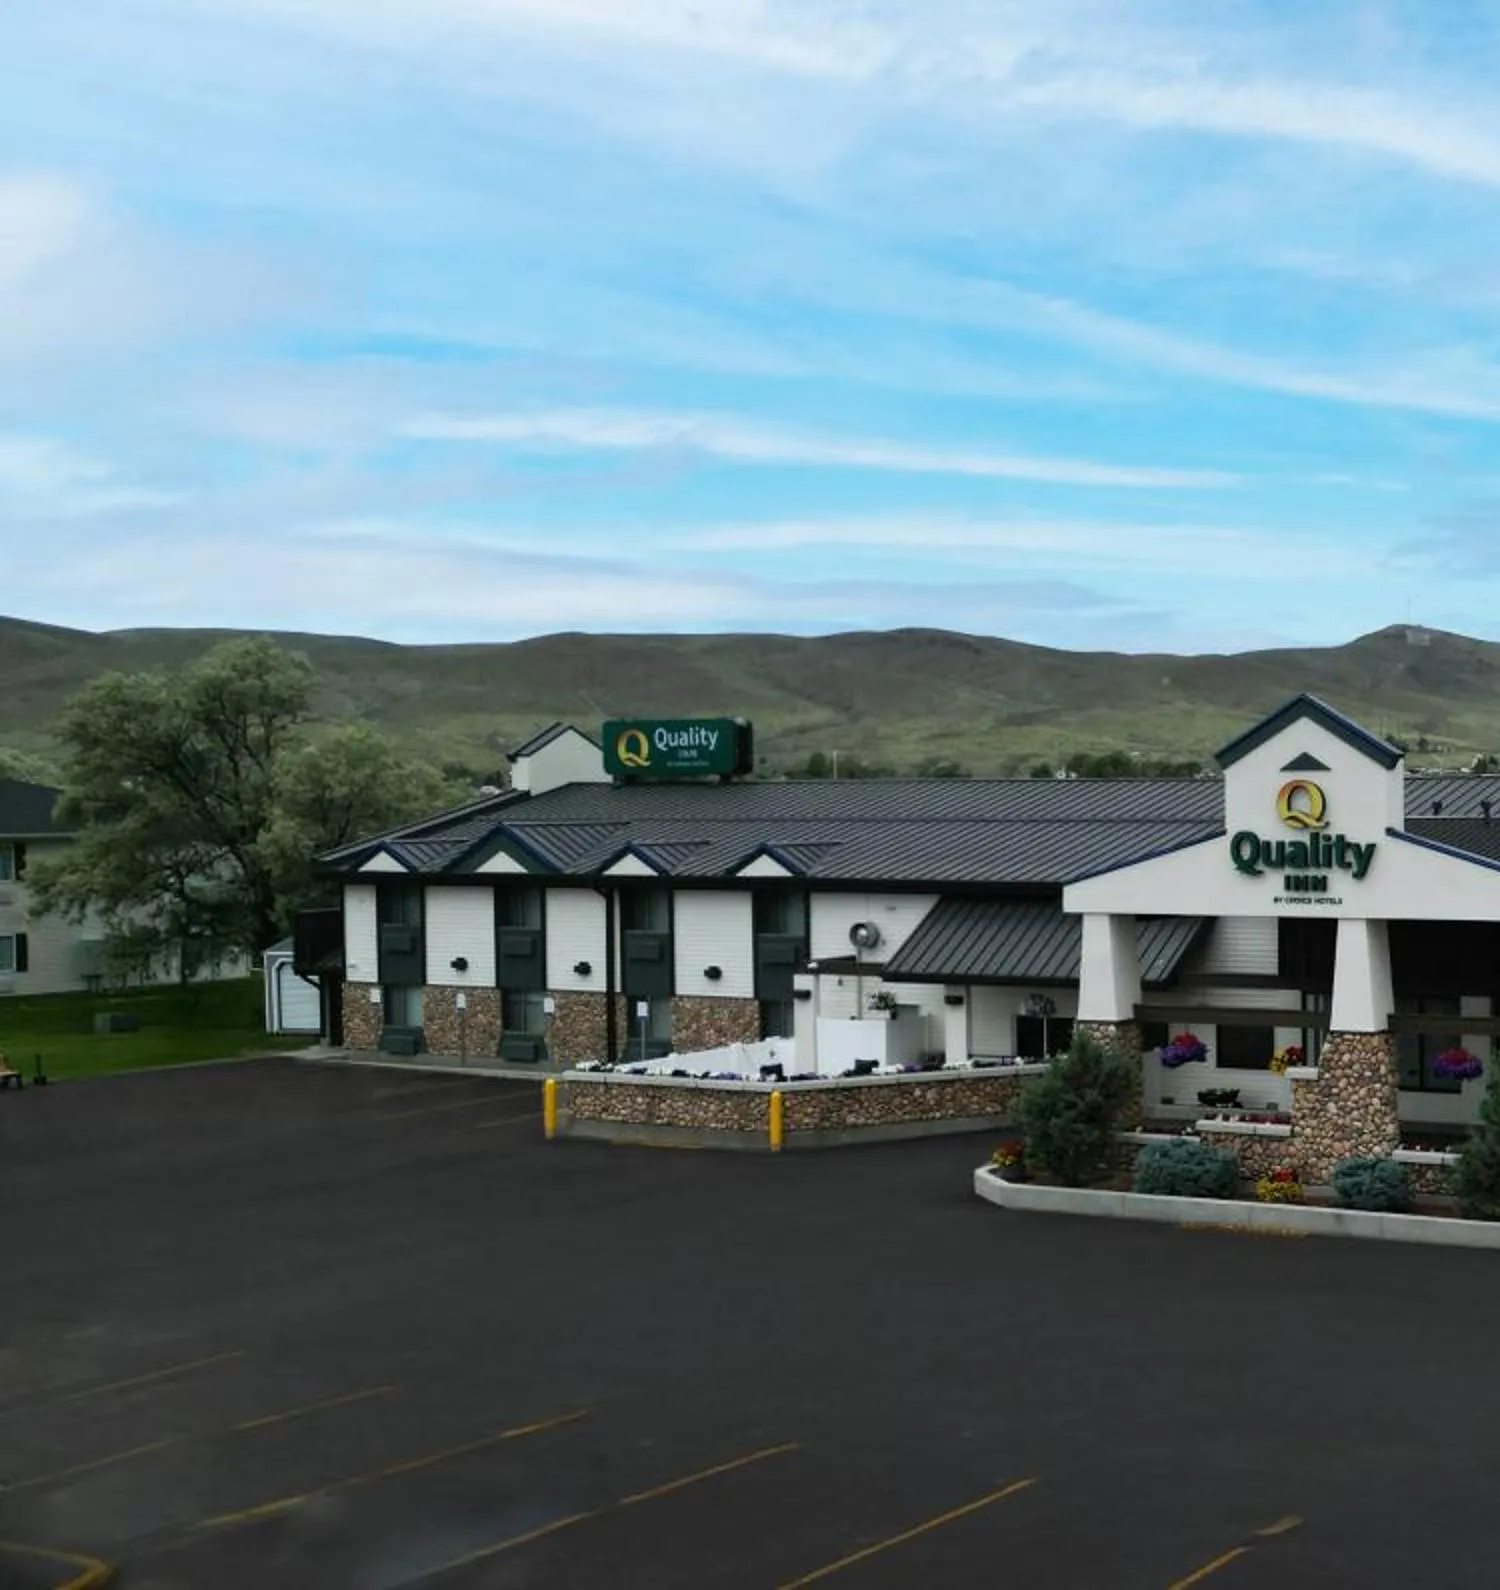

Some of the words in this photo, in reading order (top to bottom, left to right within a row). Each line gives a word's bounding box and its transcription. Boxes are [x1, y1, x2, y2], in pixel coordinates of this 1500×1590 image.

[617, 728, 651, 766] Q
[654, 726, 719, 750] Quality
[1277, 779, 1330, 829] Q
[1230, 830, 1377, 880] Quality
[1284, 874, 1328, 892] INN
